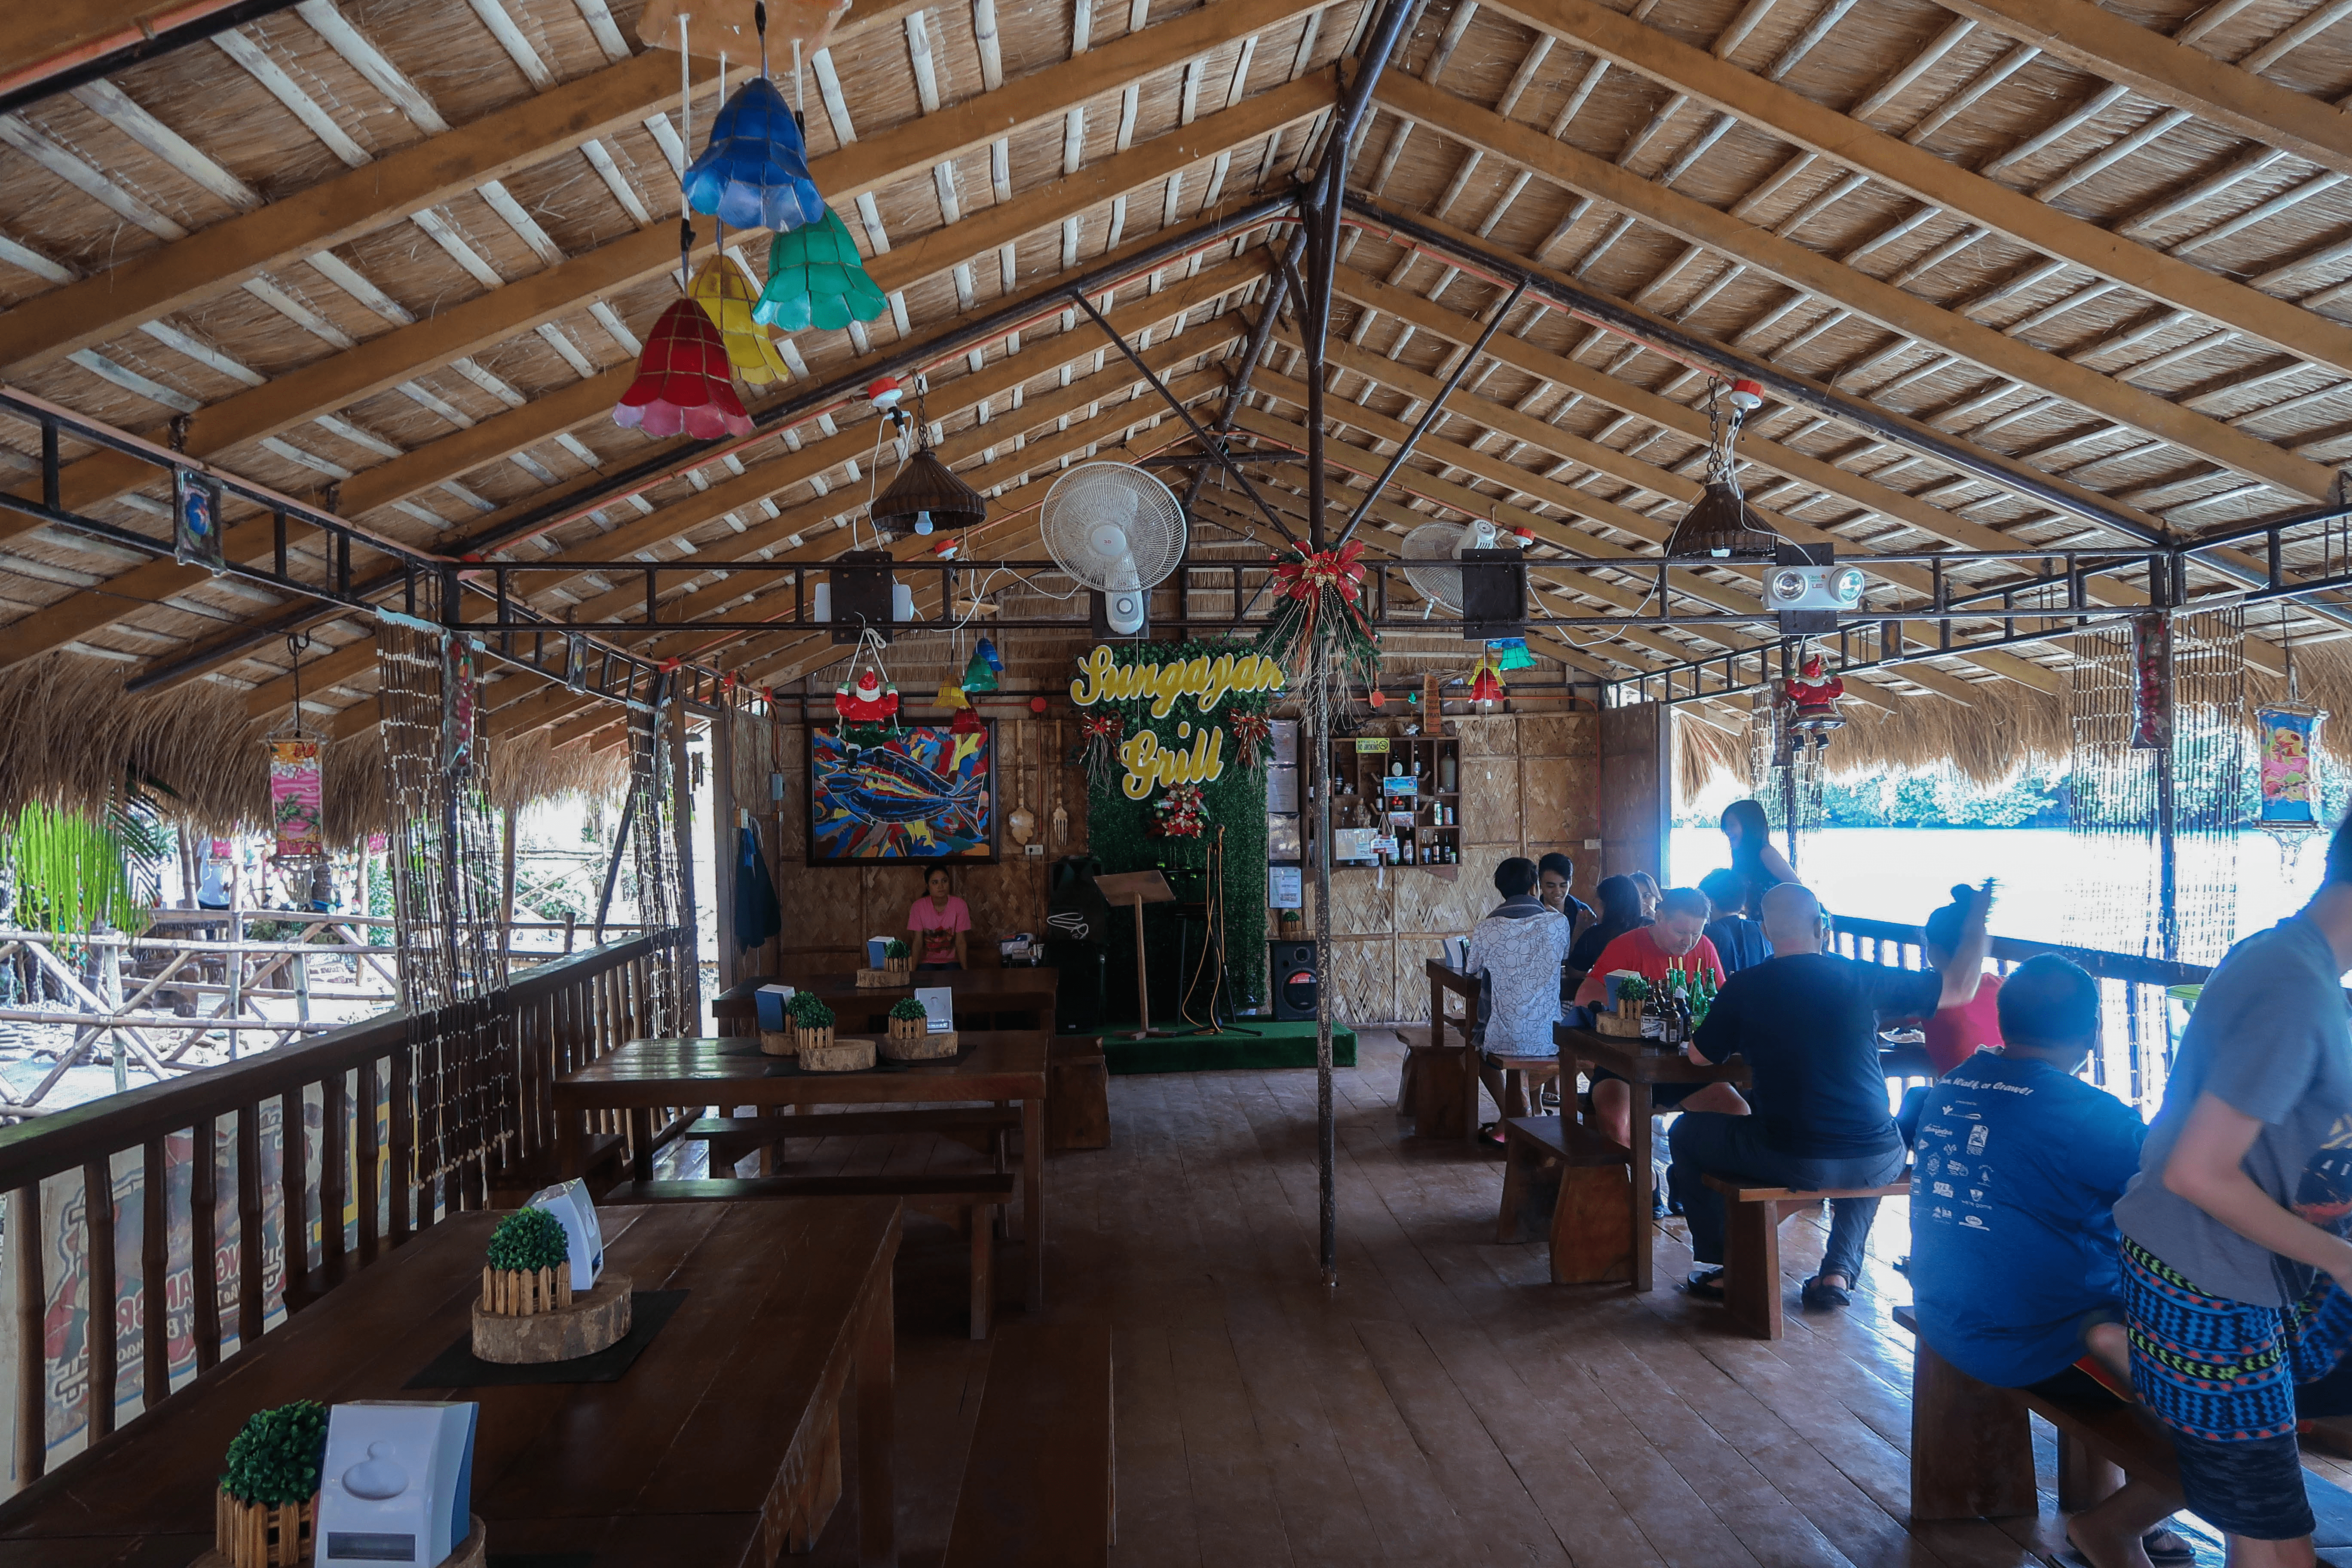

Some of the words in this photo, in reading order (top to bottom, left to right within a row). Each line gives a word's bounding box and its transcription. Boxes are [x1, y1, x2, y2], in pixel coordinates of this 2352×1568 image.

[1070, 645, 1285, 719] Sungayan
[1119, 721, 1224, 800] Grill
[1992, 1082, 2035, 1096] Crawl!
